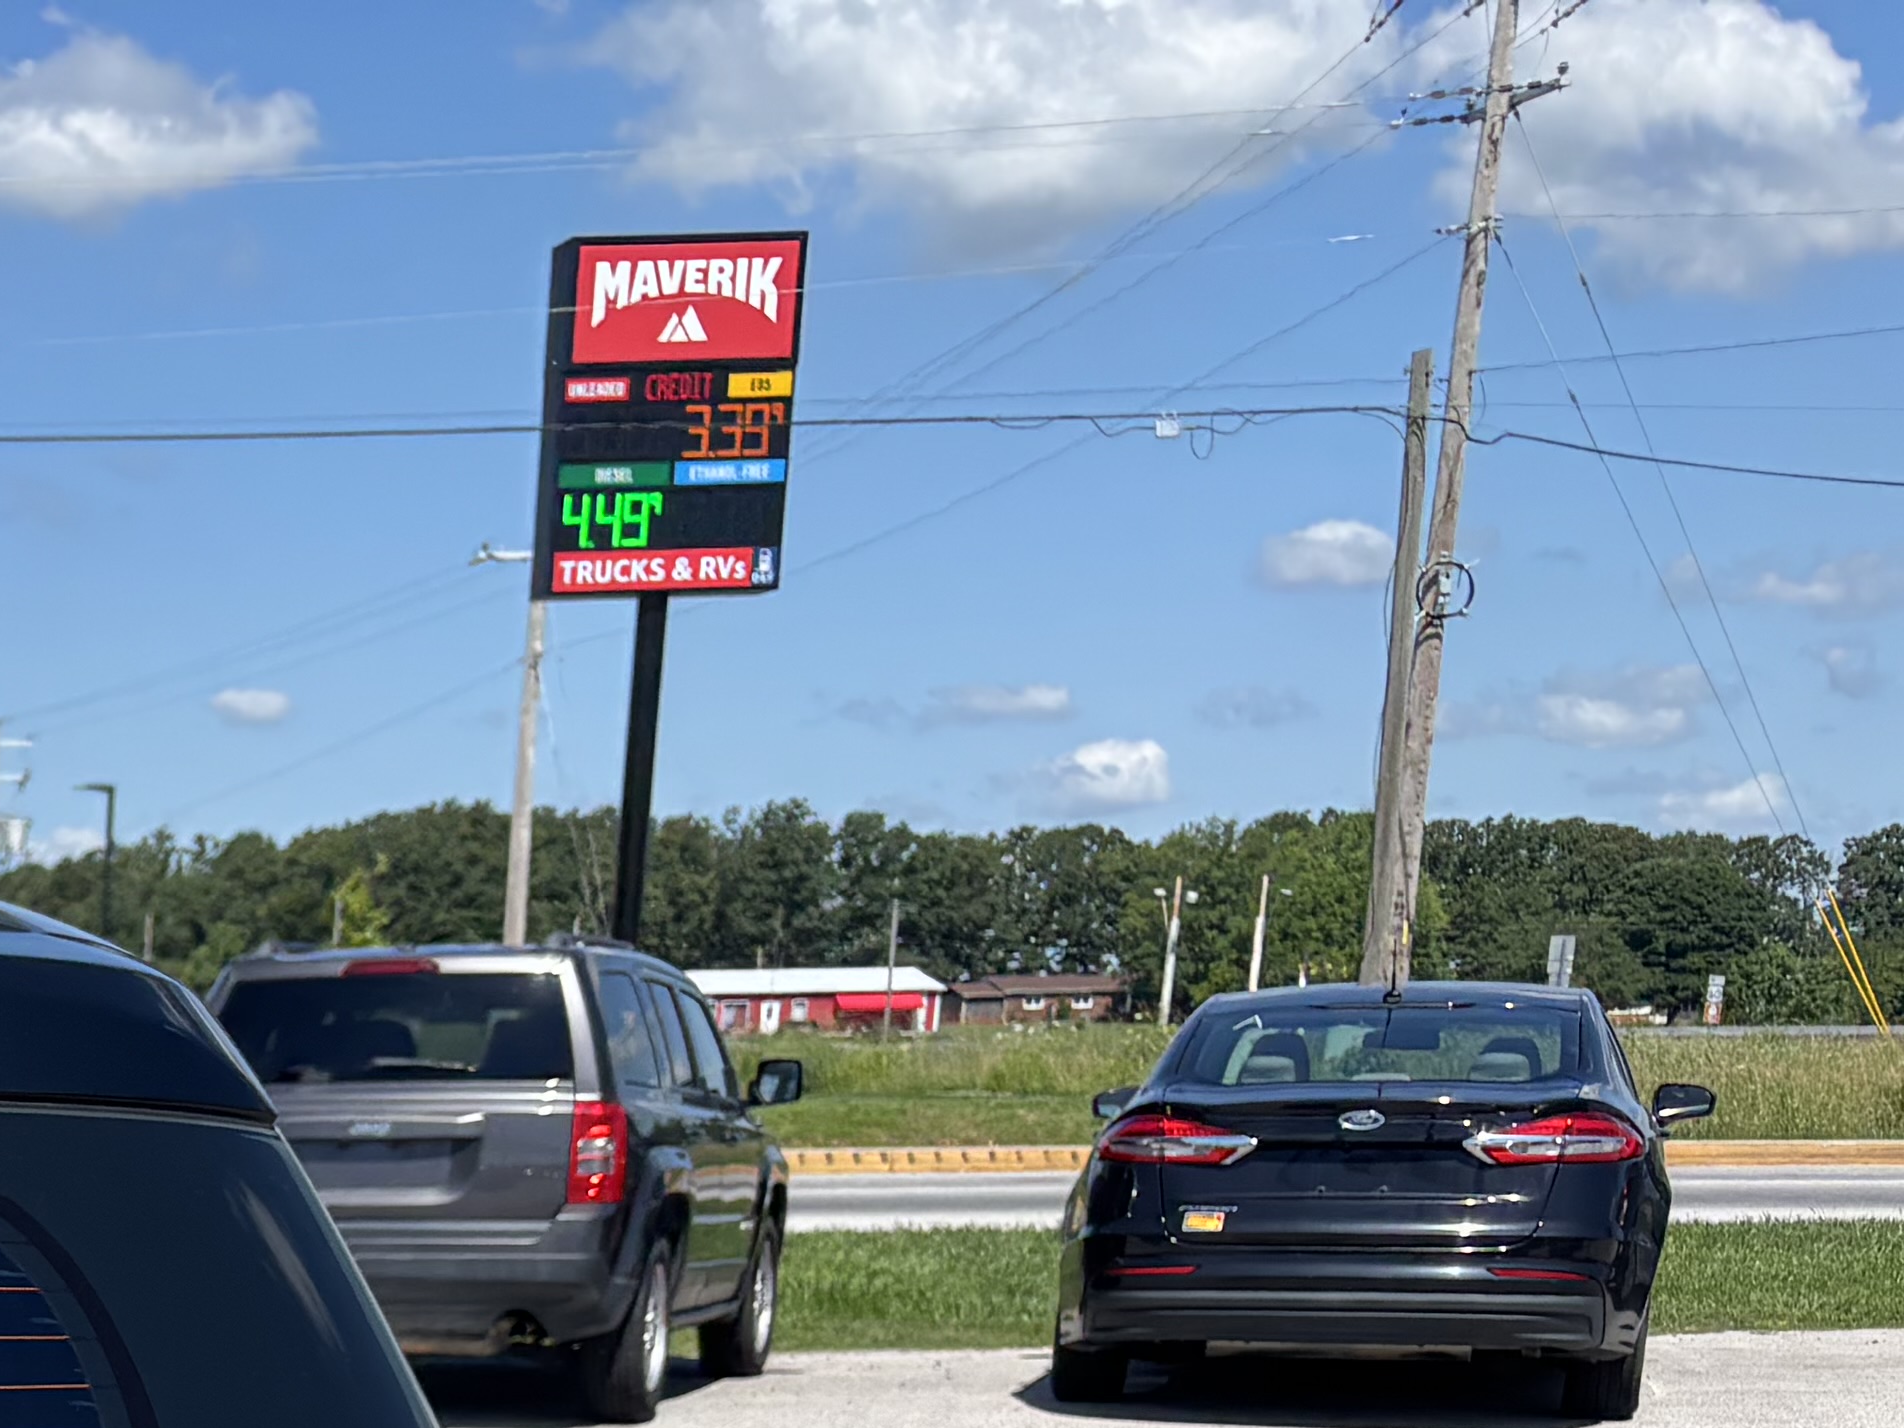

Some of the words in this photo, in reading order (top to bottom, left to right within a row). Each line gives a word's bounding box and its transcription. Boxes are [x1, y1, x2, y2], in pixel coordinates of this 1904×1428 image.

[591, 256, 784, 328] MAVERIK
[645, 372, 714, 400] CREDIT
[560, 557, 666, 585] TRUCKS
[671, 556, 693, 582] &
[699, 555, 747, 580] RVs
